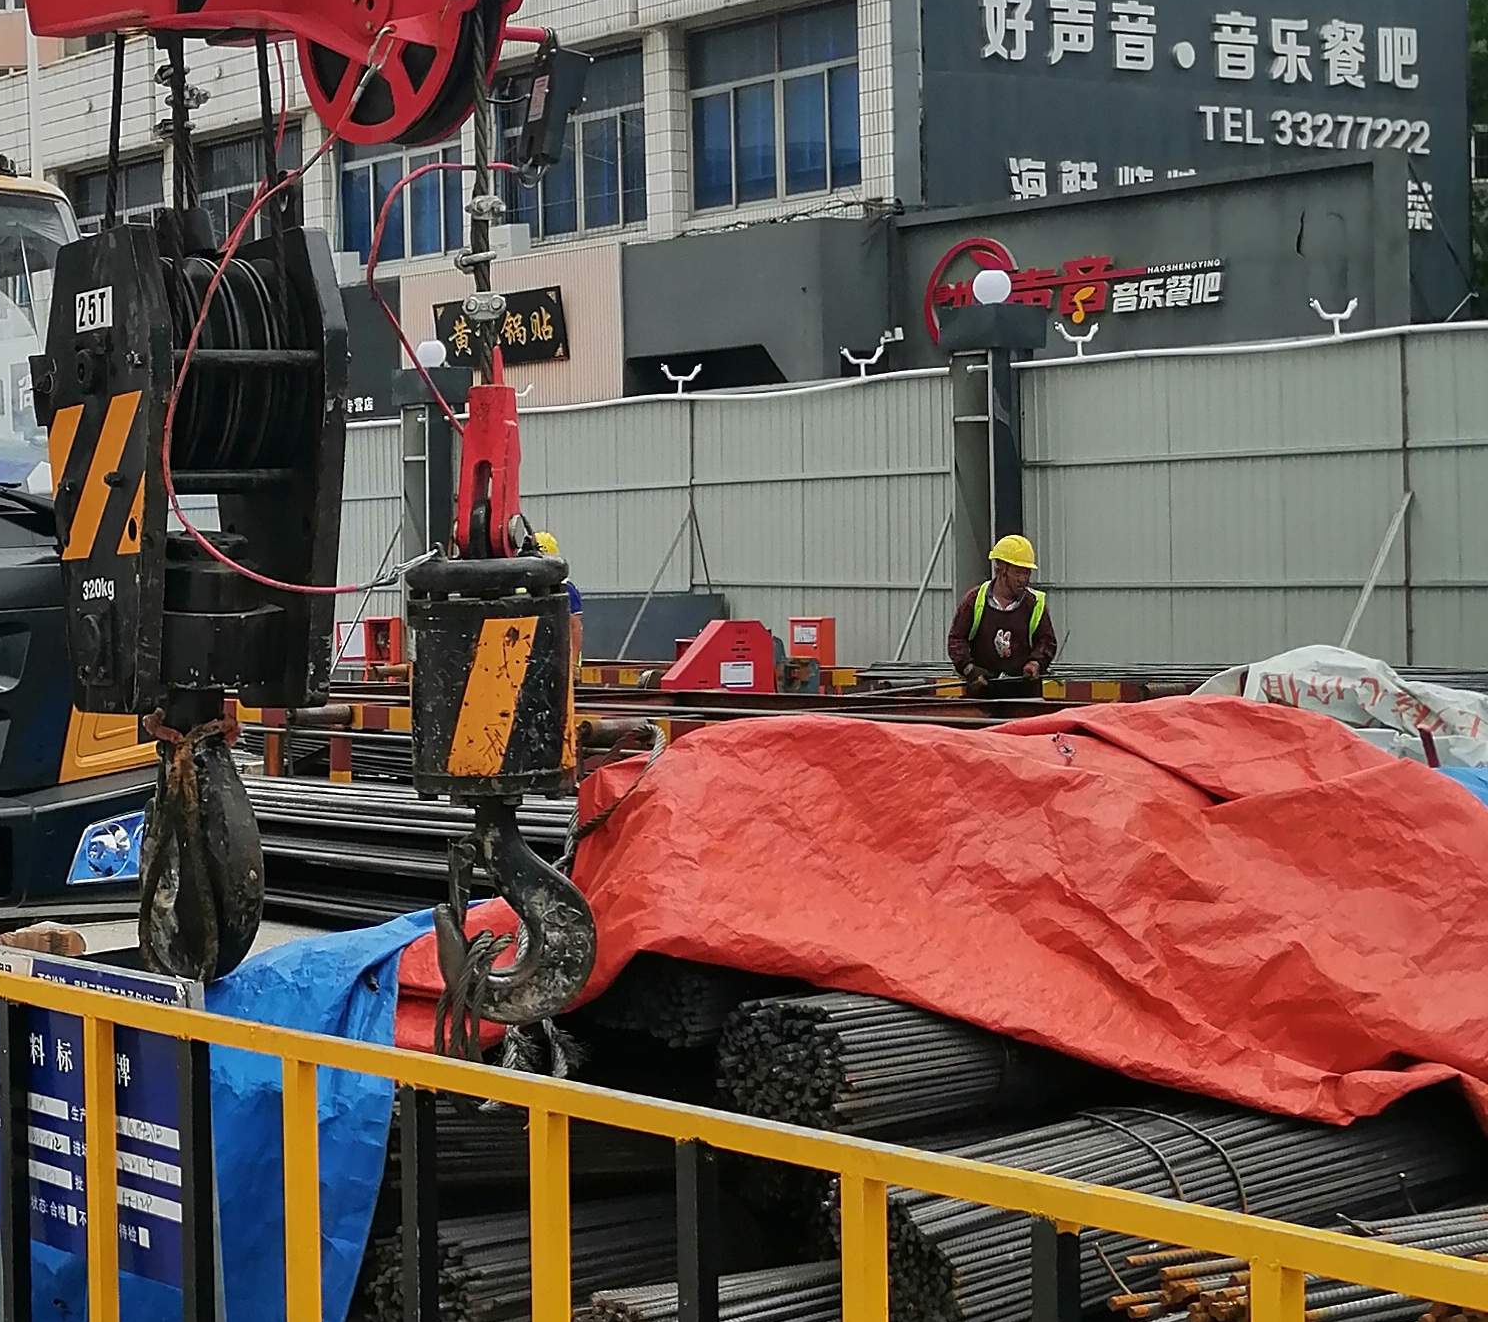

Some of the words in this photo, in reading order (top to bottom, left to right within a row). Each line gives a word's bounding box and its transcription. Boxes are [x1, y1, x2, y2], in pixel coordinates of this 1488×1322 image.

[1198, 105, 1265, 145] TEL
[1270, 109, 1431, 155] 33277222
[78, 291, 107, 328] 25T
[1112, 271, 1222, 314] 音乐餐吧
[448, 305, 554, 358] 黄锅贴
[82, 577, 114, 601] 320kg
